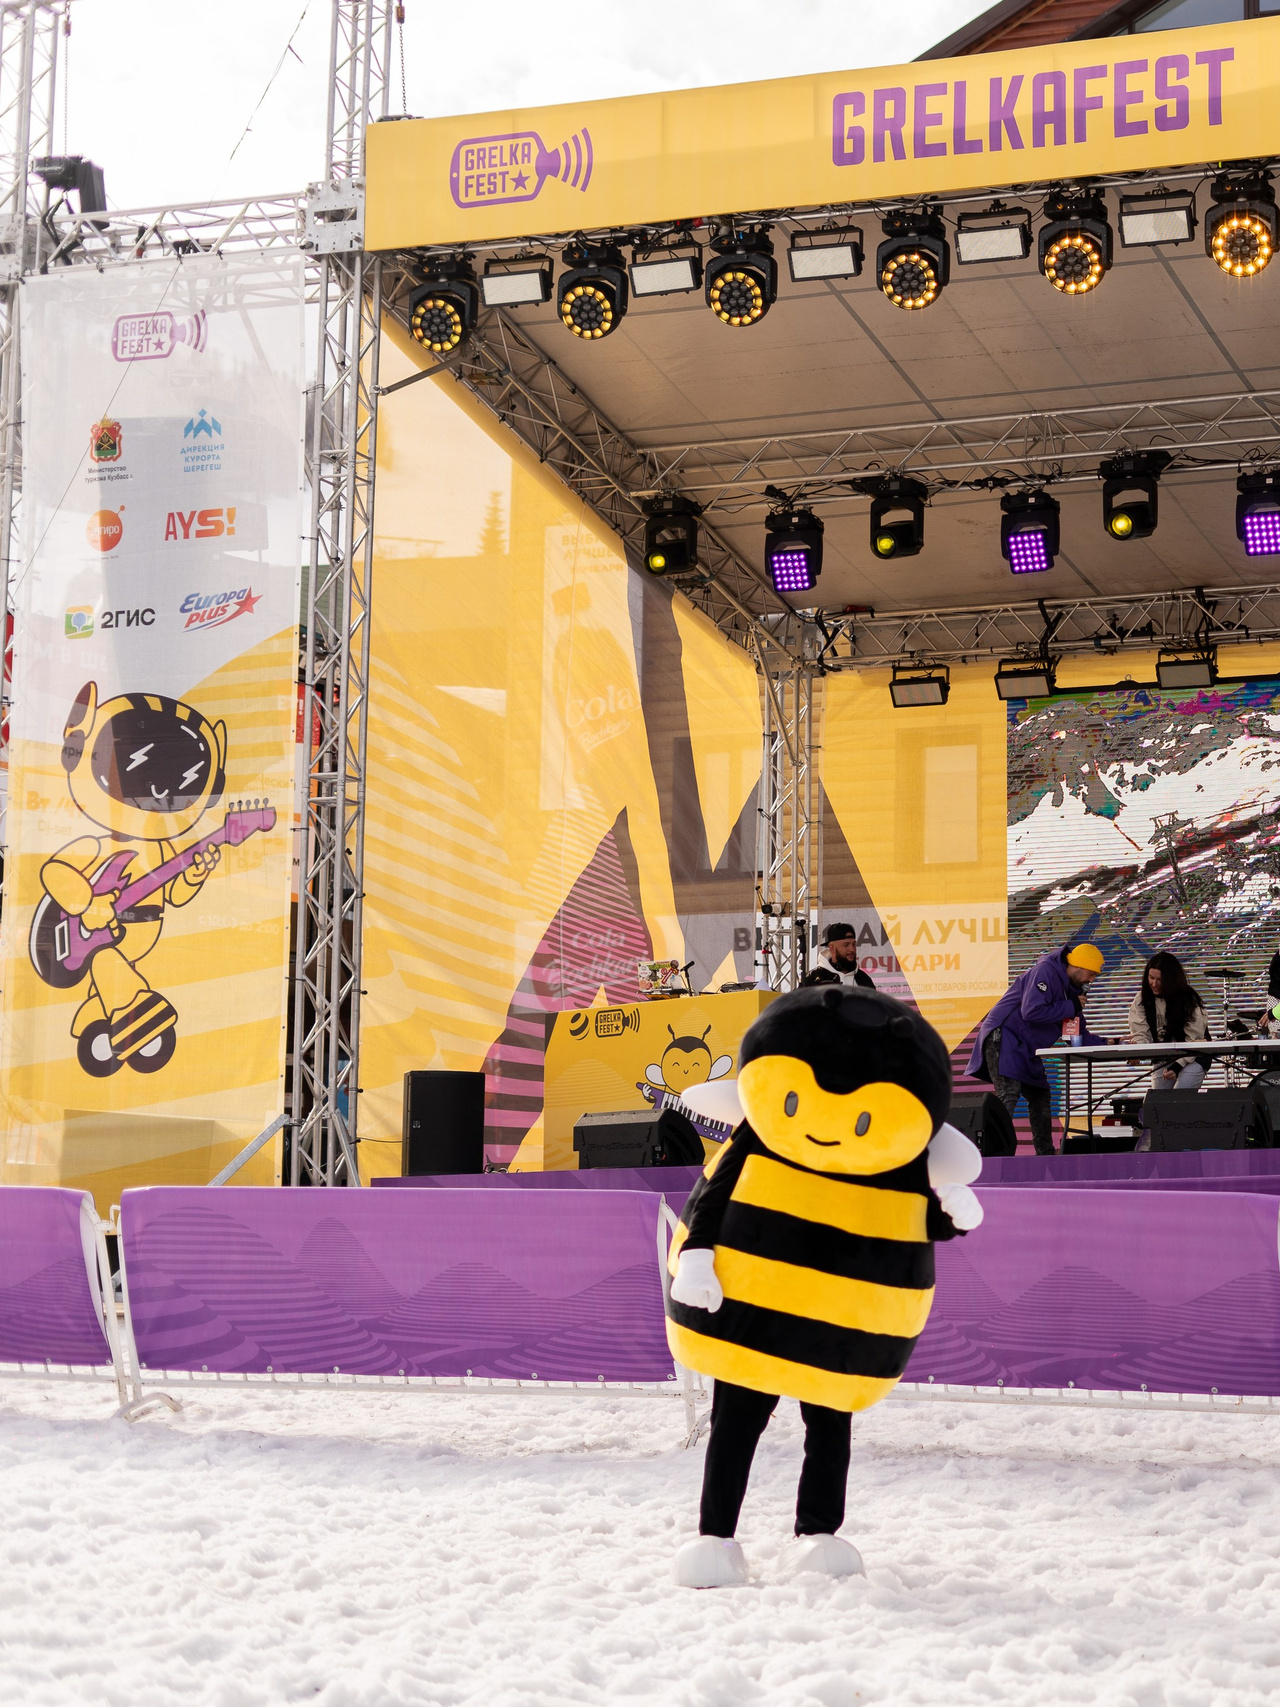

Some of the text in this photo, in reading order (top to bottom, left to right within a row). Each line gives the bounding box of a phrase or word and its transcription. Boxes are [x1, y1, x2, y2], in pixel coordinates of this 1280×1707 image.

[832, 47, 1235, 167] GRELKAFEST
[464, 142, 531, 171] GRELKA
[464, 171, 510, 198] FEST
[121, 319, 167, 337] GRELKA
[120, 338, 152, 355] FEST
[180, 444, 225, 455] ДИРЕКЦИЯ
[184, 455, 221, 463] КУРОРТА
[87, 466, 127, 474] Министерство
[183, 464, 222, 473] ШЕРЕГЕШ
[85, 476, 107, 484] туризма
[164, 507, 237, 541] AYS!
[101, 608, 156, 629] 2ГИС
[857, 952, 961, 974] ОЧКАРИ
[934, 982, 967, 992] ТОВАРОВ
[968, 980, 998, 991] РОССИИ
[600, 1012, 621, 1024] GRELKA
[600, 1024, 614, 1034] FEST
[1161, 1120, 1235, 1130] ProTone
